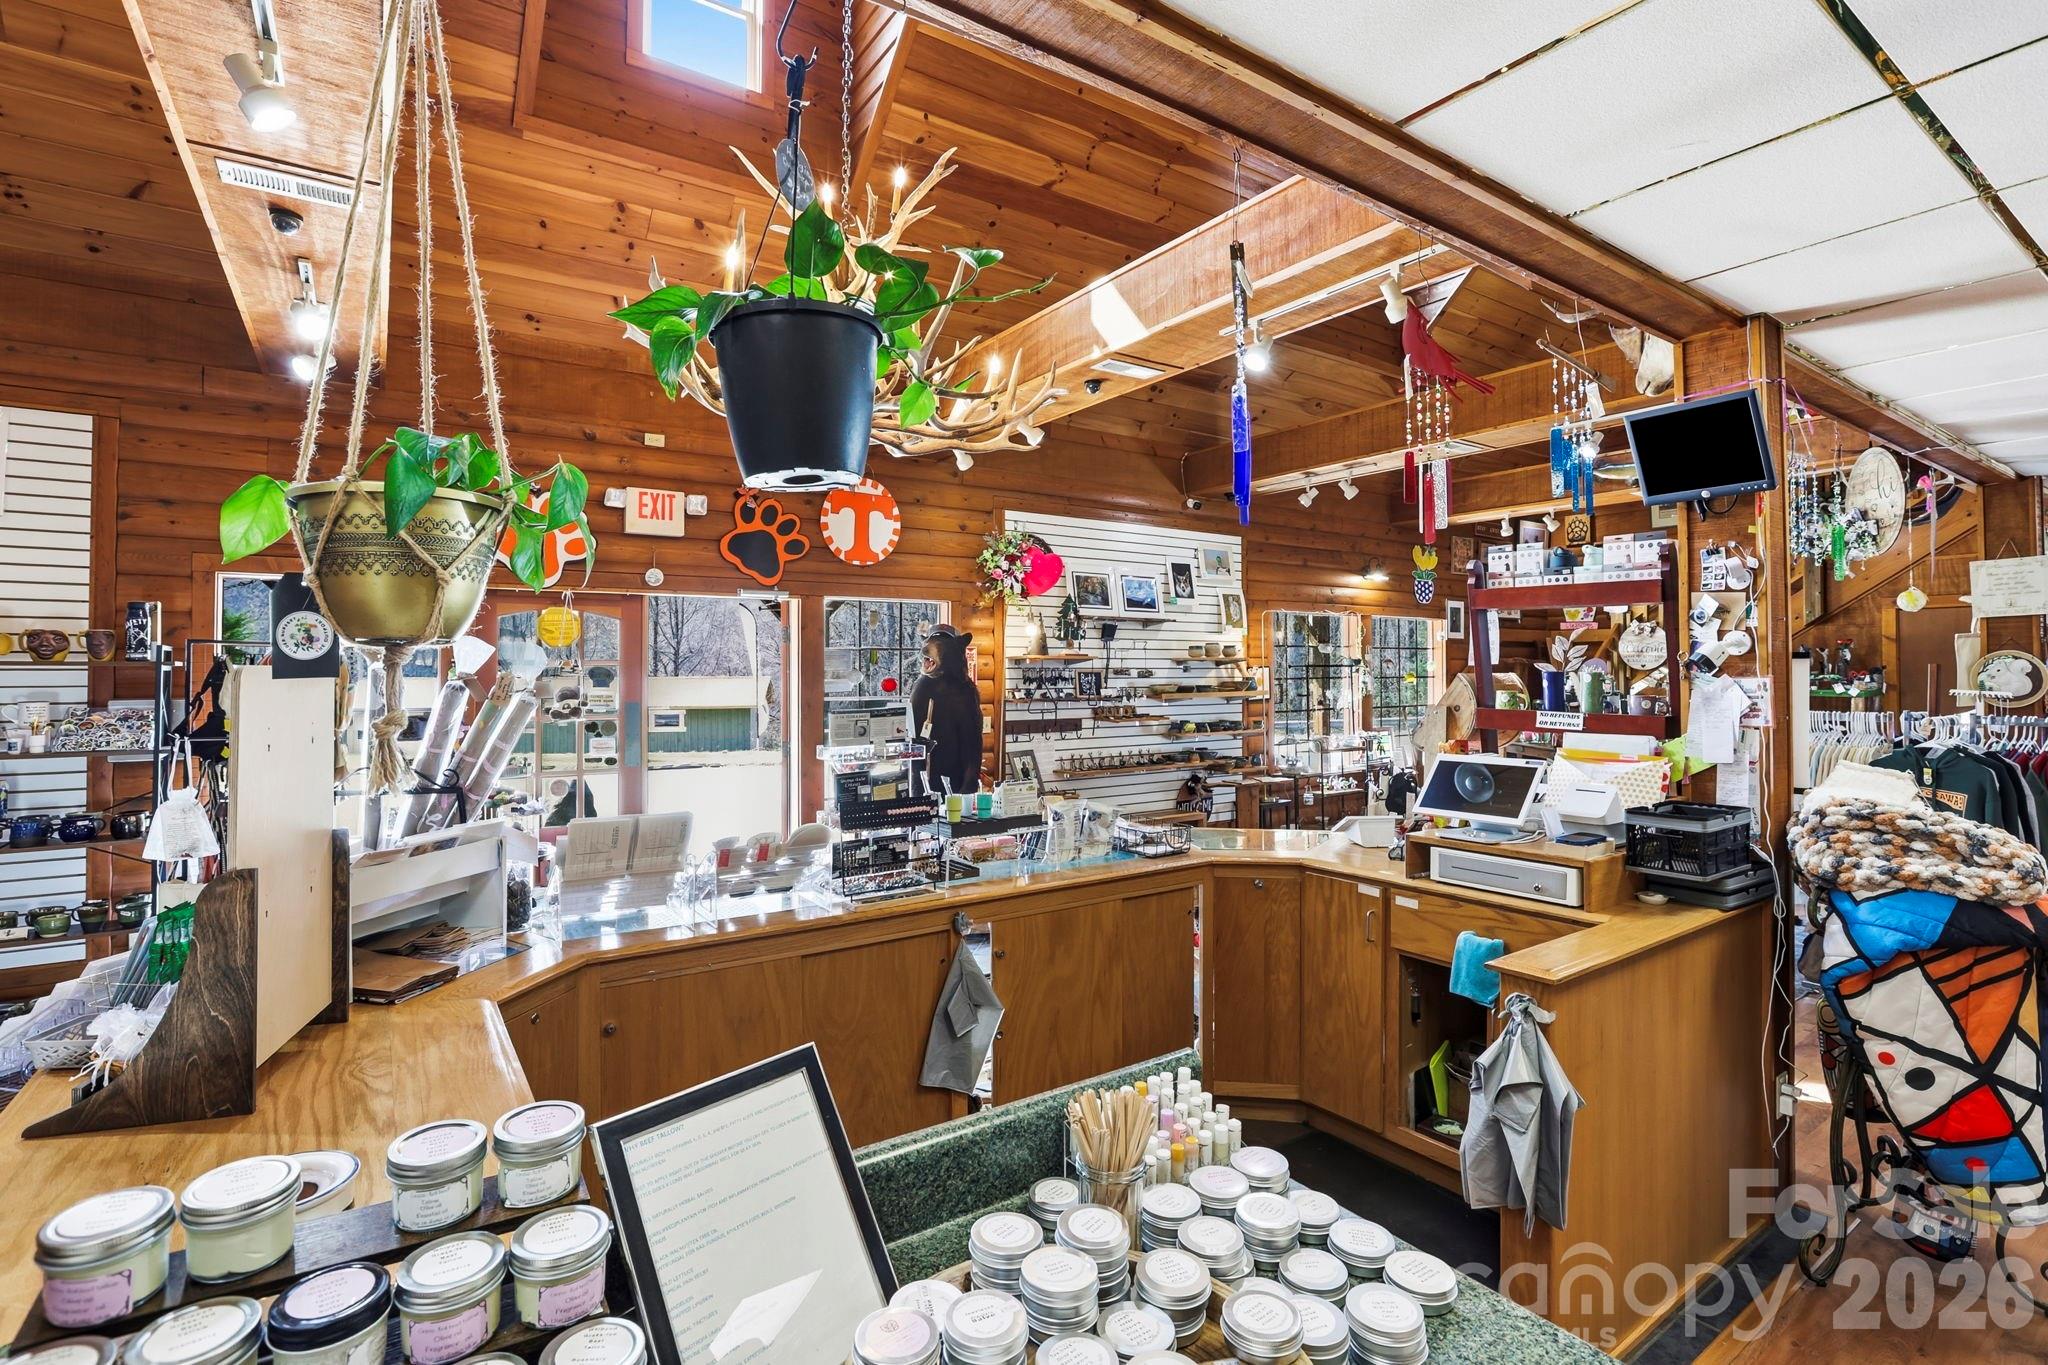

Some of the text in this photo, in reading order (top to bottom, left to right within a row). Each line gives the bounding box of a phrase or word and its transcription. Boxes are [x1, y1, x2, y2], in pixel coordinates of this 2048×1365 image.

[638, 491, 676, 521] EXIT
[830, 489, 894, 562] T
[1551, 712, 1580, 720] REFUNDS
[638, 1134, 655, 1146] BEEF
